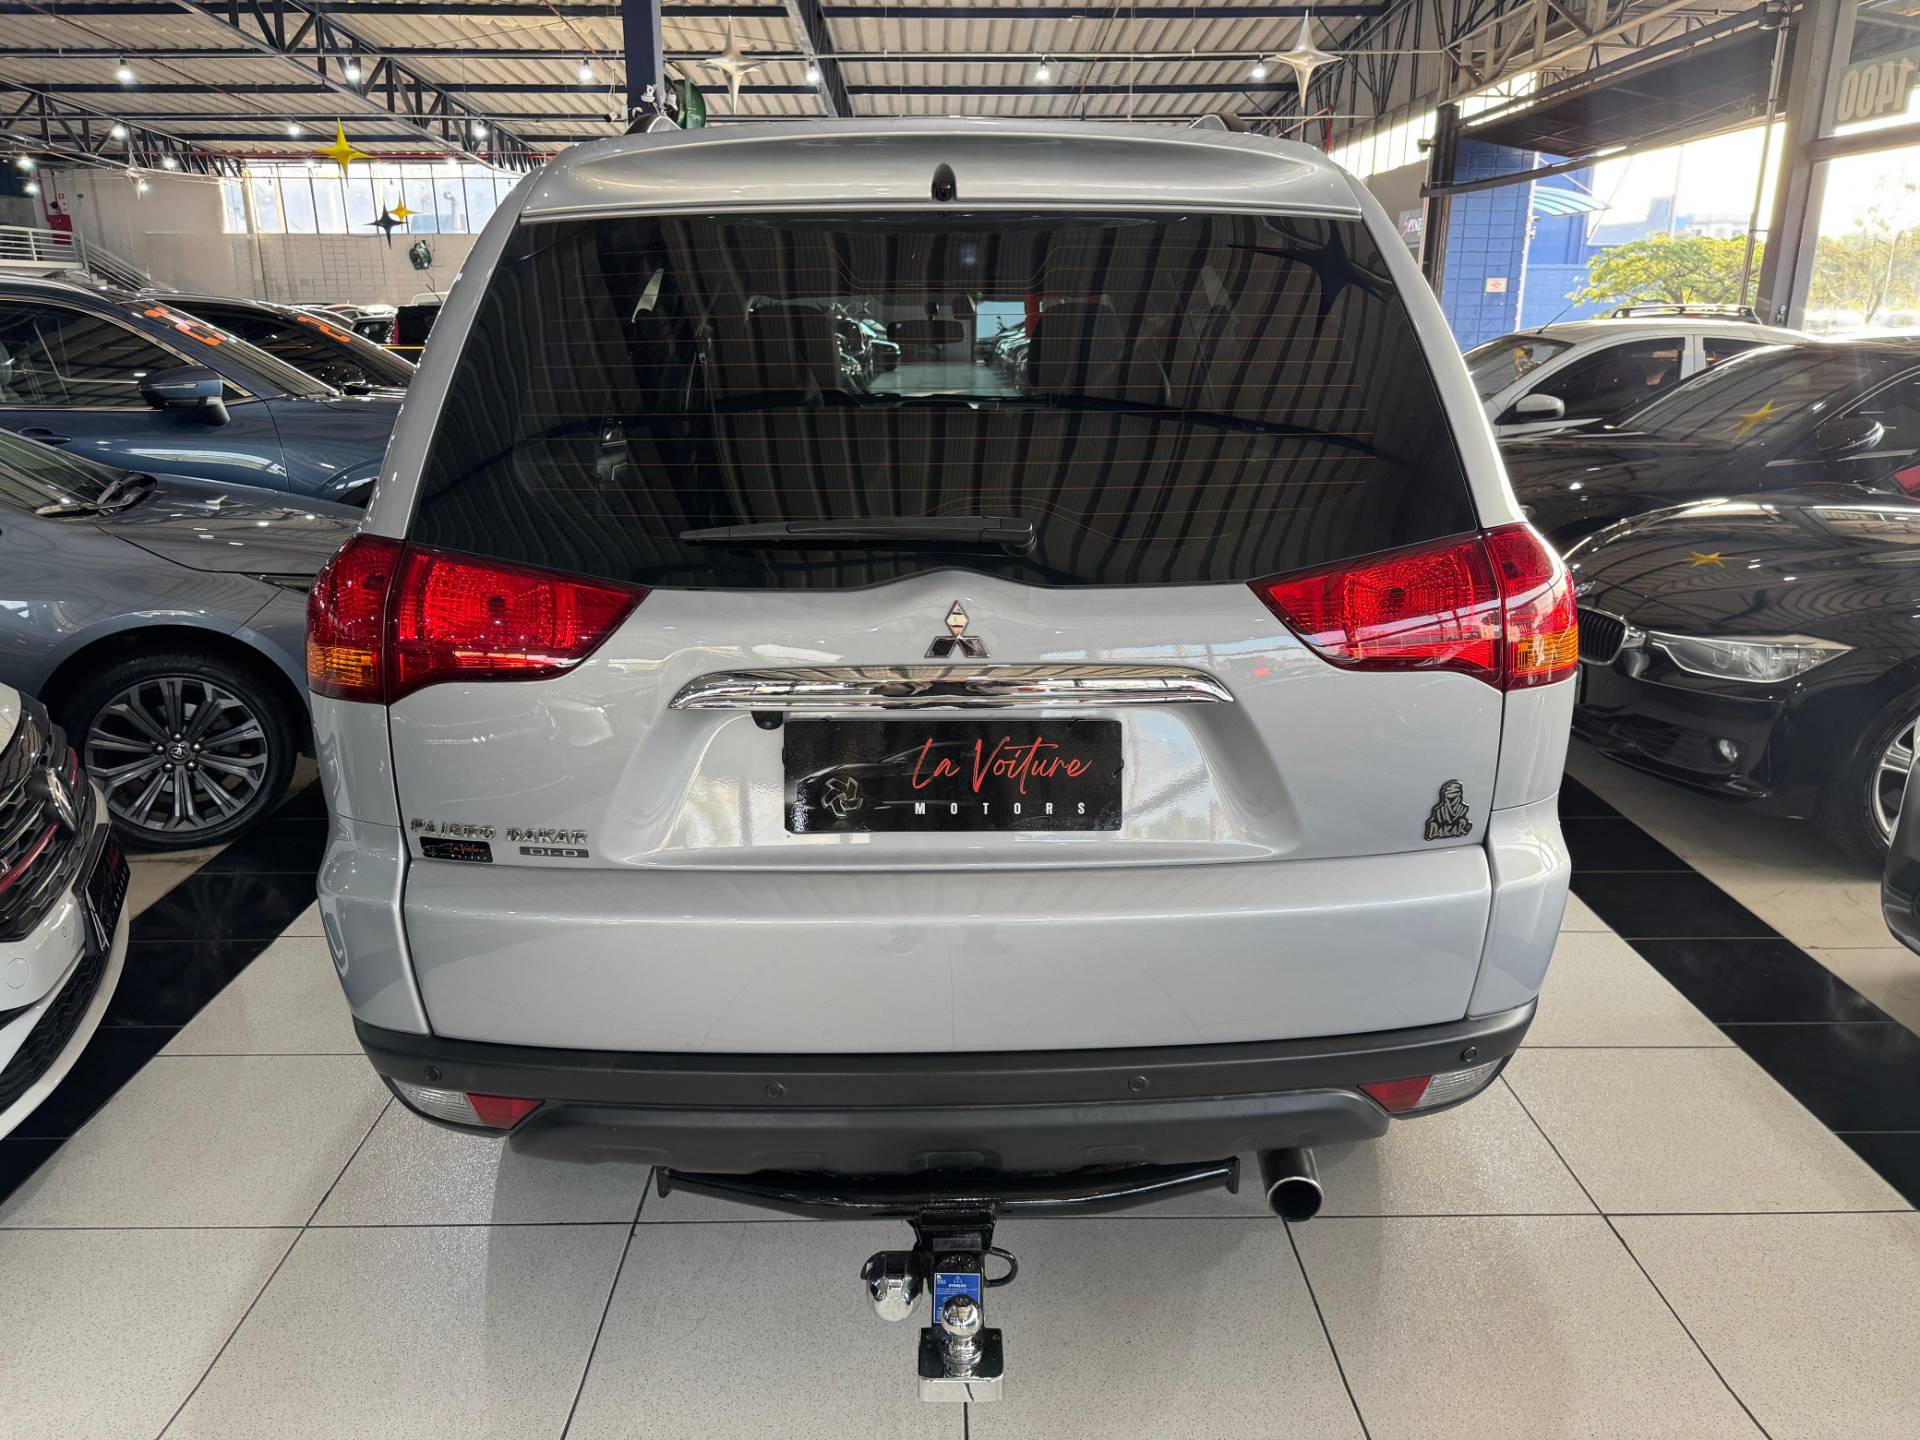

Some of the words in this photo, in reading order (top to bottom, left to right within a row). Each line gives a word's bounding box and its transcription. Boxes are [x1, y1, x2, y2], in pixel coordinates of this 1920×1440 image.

[911, 737, 960, 789] La
[971, 735, 1092, 795] Voiture
[915, 802, 1085, 815] MOTORS
[410, 817, 496, 840] PAJERO
[505, 827, 588, 844] DAKAR
[529, 848, 578, 857] DI-D
